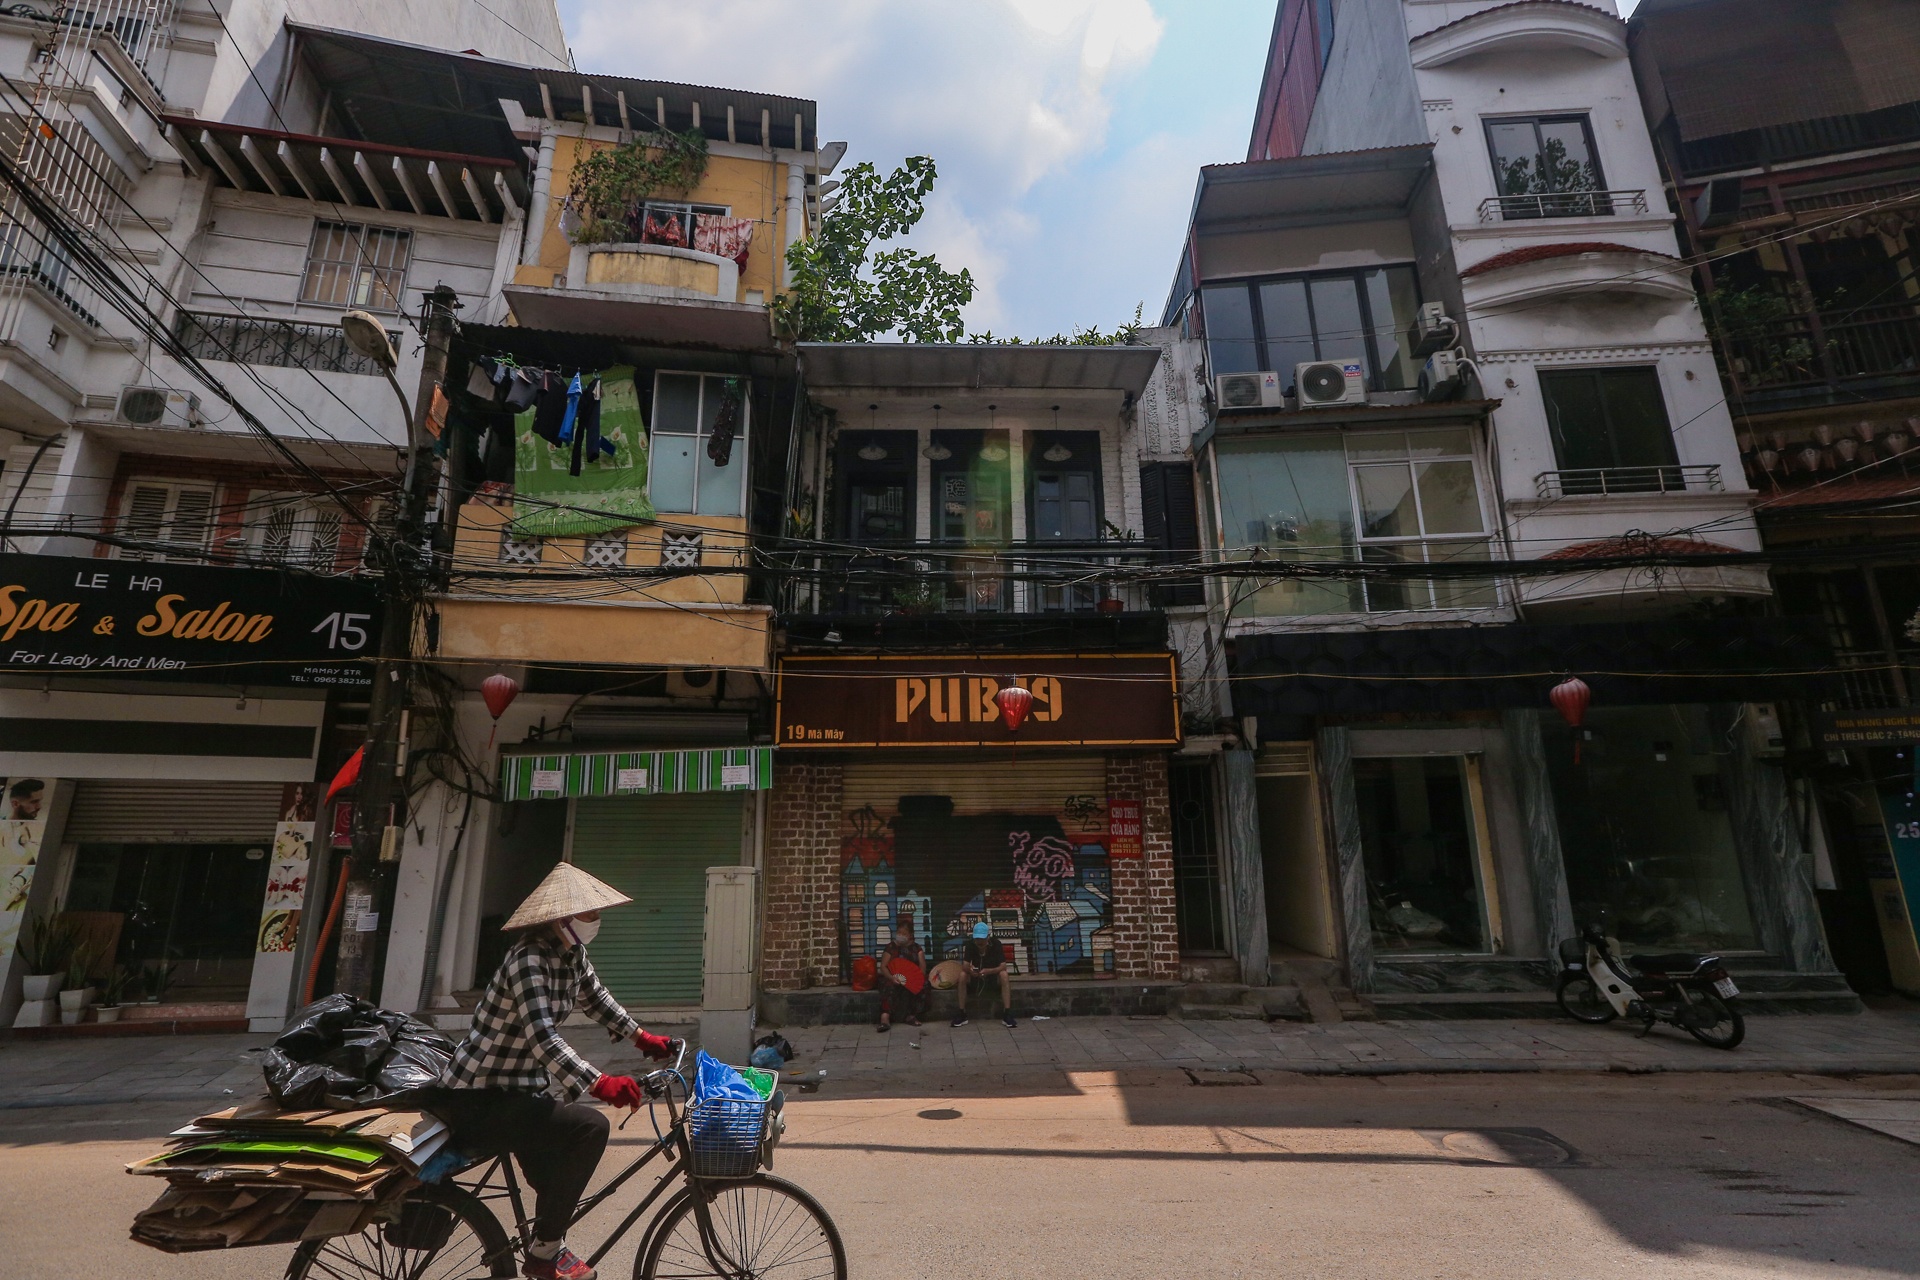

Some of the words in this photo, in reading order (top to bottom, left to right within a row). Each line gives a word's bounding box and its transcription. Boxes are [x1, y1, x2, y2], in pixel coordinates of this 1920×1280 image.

[75, 572, 110, 589] LE
[129, 575, 163, 592] HA
[0, 584, 81, 641] Spa
[92, 615, 115, 635] &
[136, 594, 274, 643] Salon
[311, 612, 371, 650] 15
[9, 650, 45, 664] For
[48, 652, 98, 668] Lady
[100, 655, 143, 668] And
[145, 657, 186, 670] Men
[303, 667, 341, 675] MAMAY
[895, 677, 1000, 722] PUB
[786, 724, 806, 740] 19
[824, 728, 845, 741] Mây
[1111, 807, 1123, 818] CHO
[1895, 822, 1920, 839] 25
